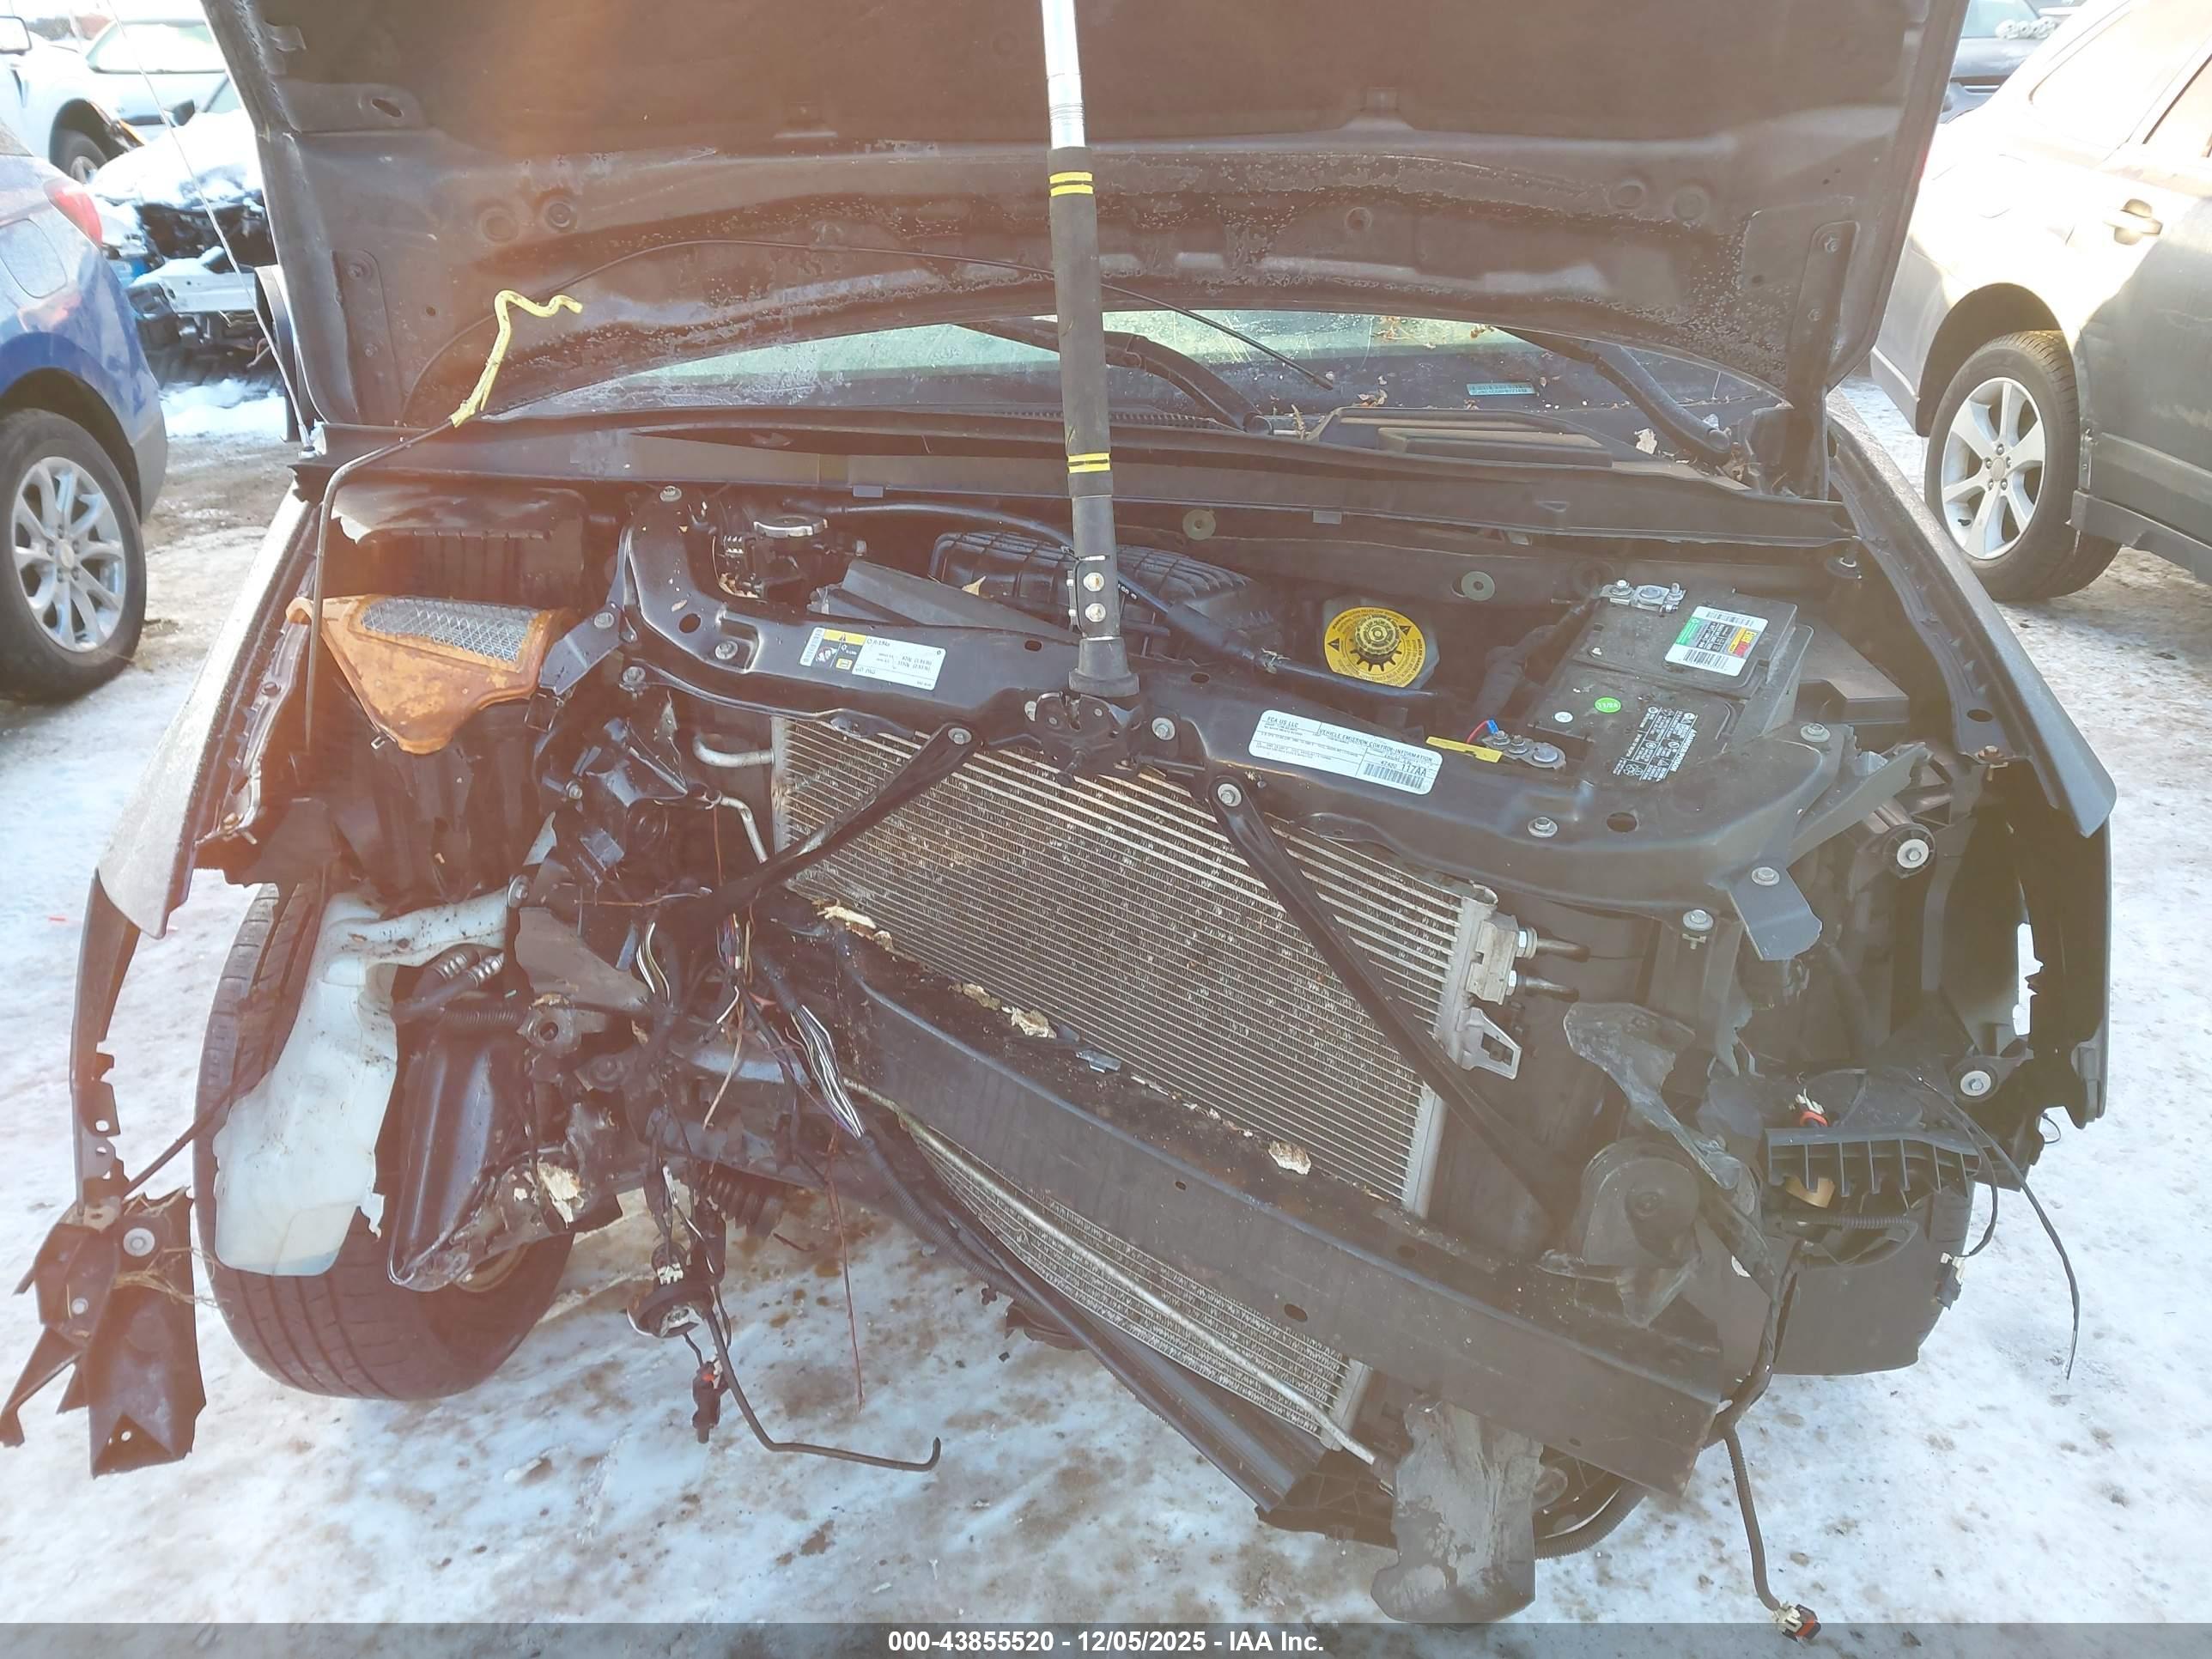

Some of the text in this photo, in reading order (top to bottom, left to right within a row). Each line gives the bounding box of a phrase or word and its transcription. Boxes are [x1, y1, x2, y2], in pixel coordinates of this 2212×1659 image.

[1319, 729, 1341, 738] VEHICLE
[1369, 741, 1394, 753] CONTROL
[1395, 748, 1433, 763] INFORMATION
